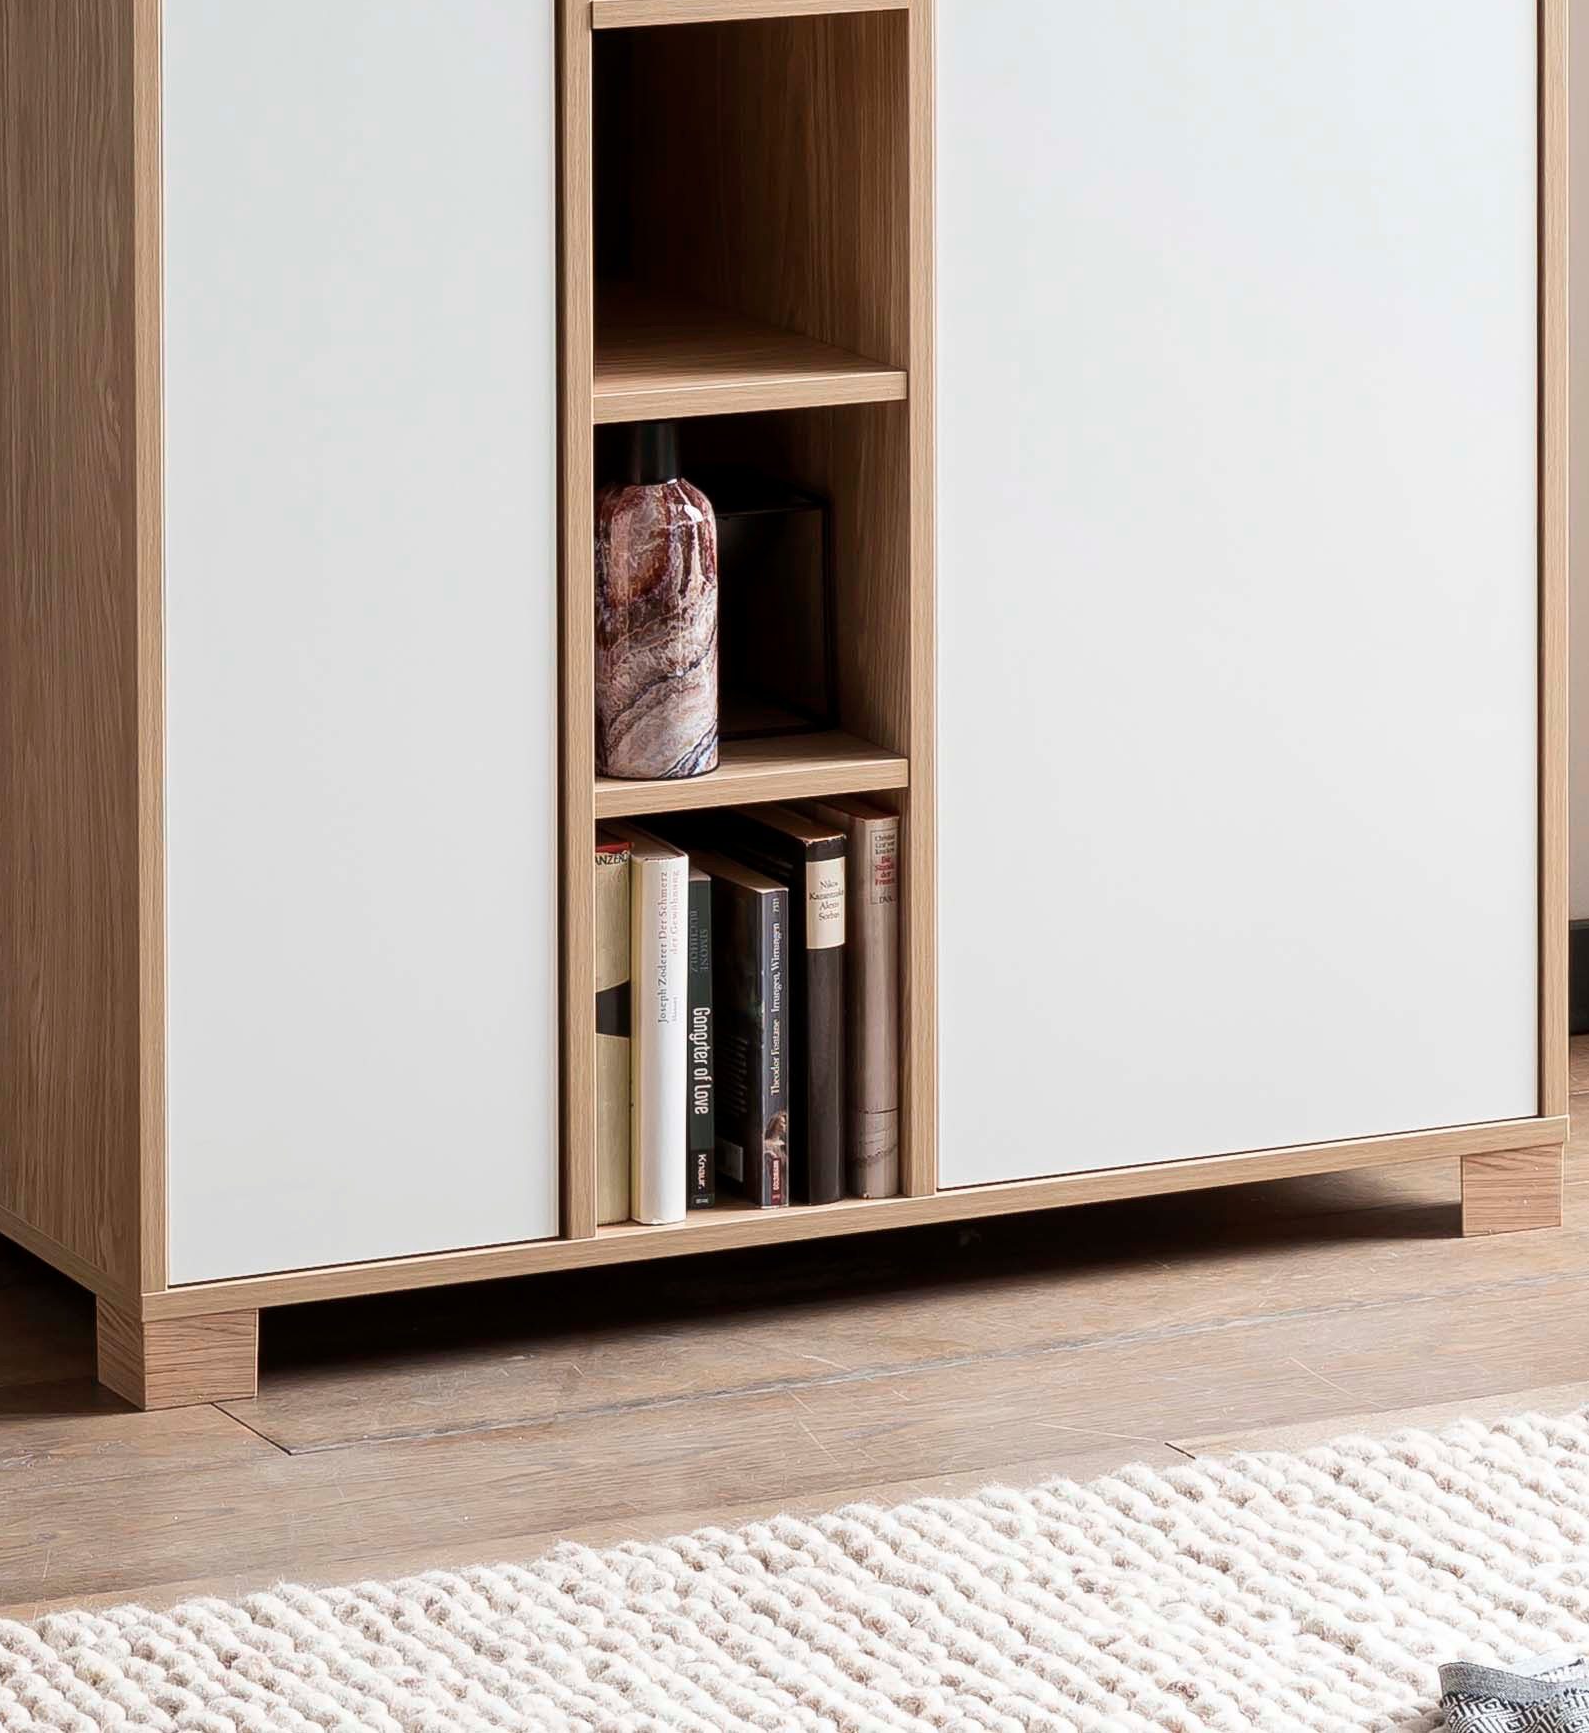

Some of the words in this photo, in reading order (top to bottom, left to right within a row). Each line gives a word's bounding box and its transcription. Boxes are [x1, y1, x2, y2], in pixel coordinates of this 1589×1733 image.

[658, 871, 668, 917] Schmerz
[658, 919, 668, 940] Der
[657, 942, 668, 987] Zoderer
[658, 988, 669, 1024] Joseph
[689, 1007, 711, 1065] Gangster
[693, 1067, 713, 1082] of
[770, 1057, 780, 1096] Theodor
[694, 1083, 712, 1115] Love
